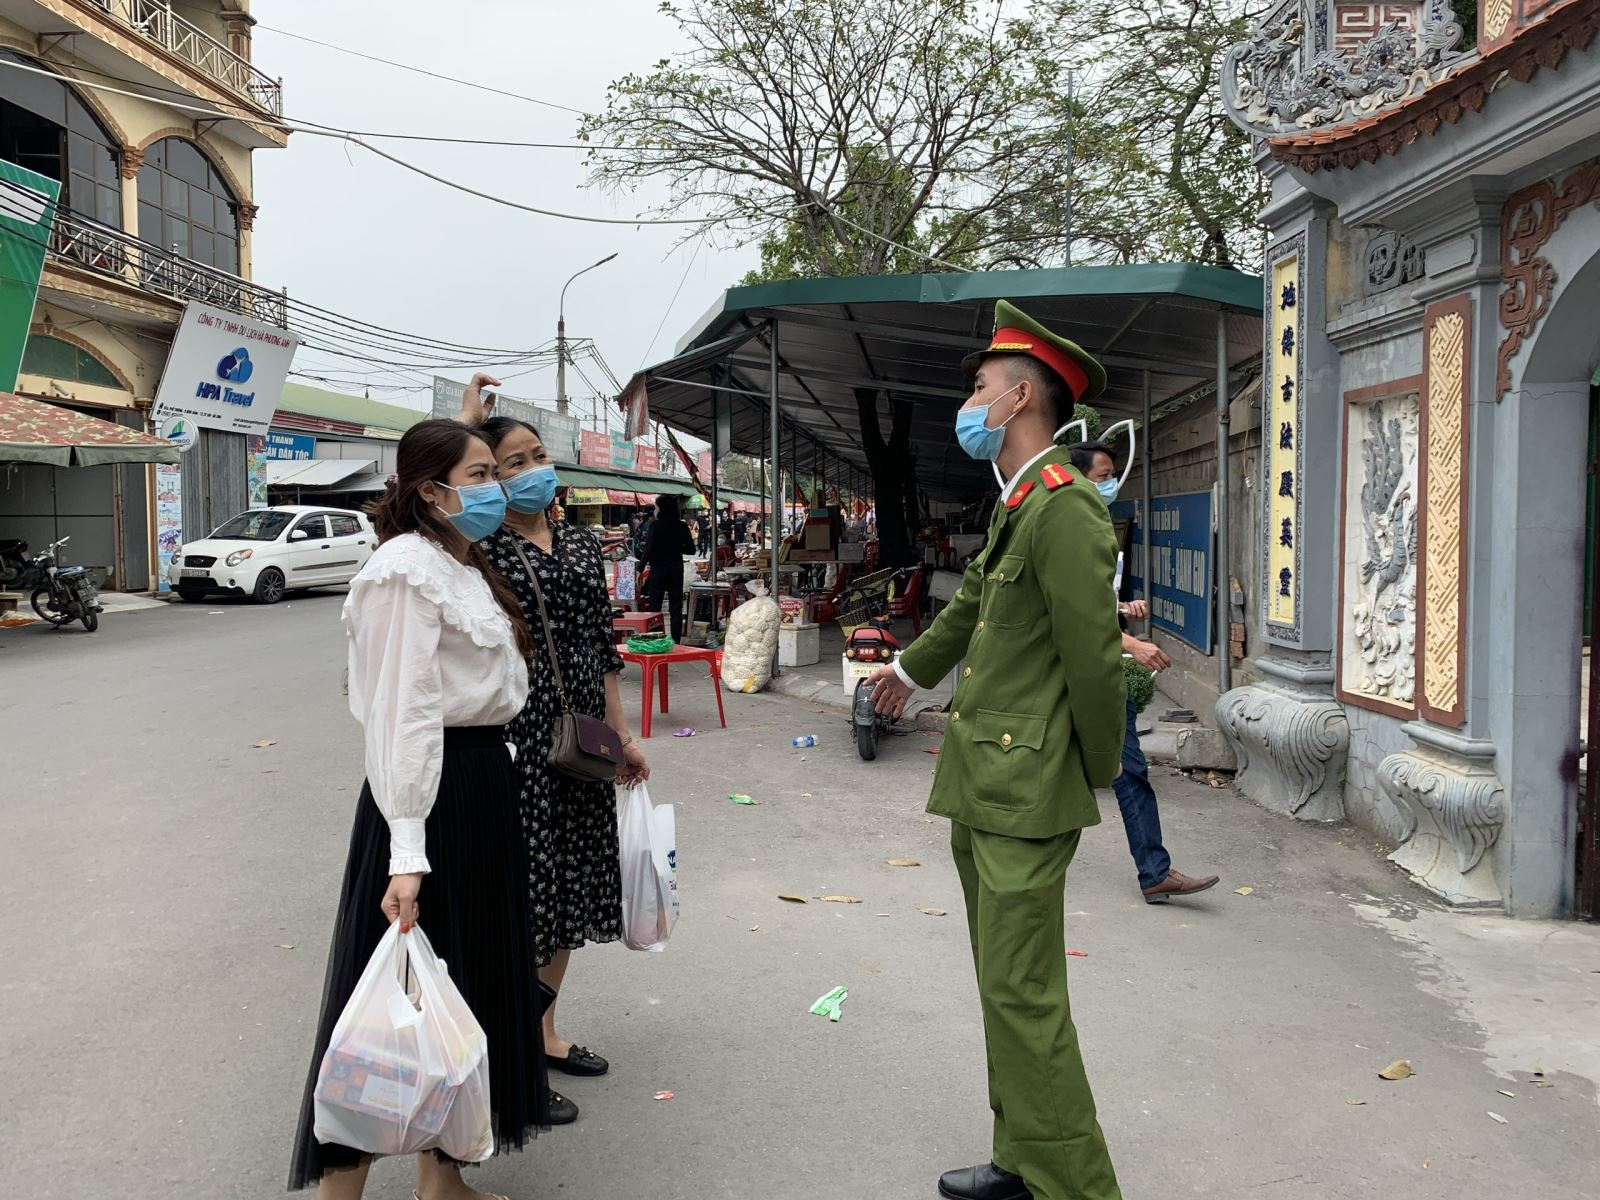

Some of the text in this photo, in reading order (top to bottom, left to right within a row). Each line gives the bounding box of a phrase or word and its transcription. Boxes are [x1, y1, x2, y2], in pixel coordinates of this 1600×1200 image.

[197, 312, 214, 327] CÔNG
[214, 318, 224, 328] TY
[223, 320, 240, 334] TNHH
[237, 324, 247, 336] DU
[195, 381, 256, 408] HPA Travel
